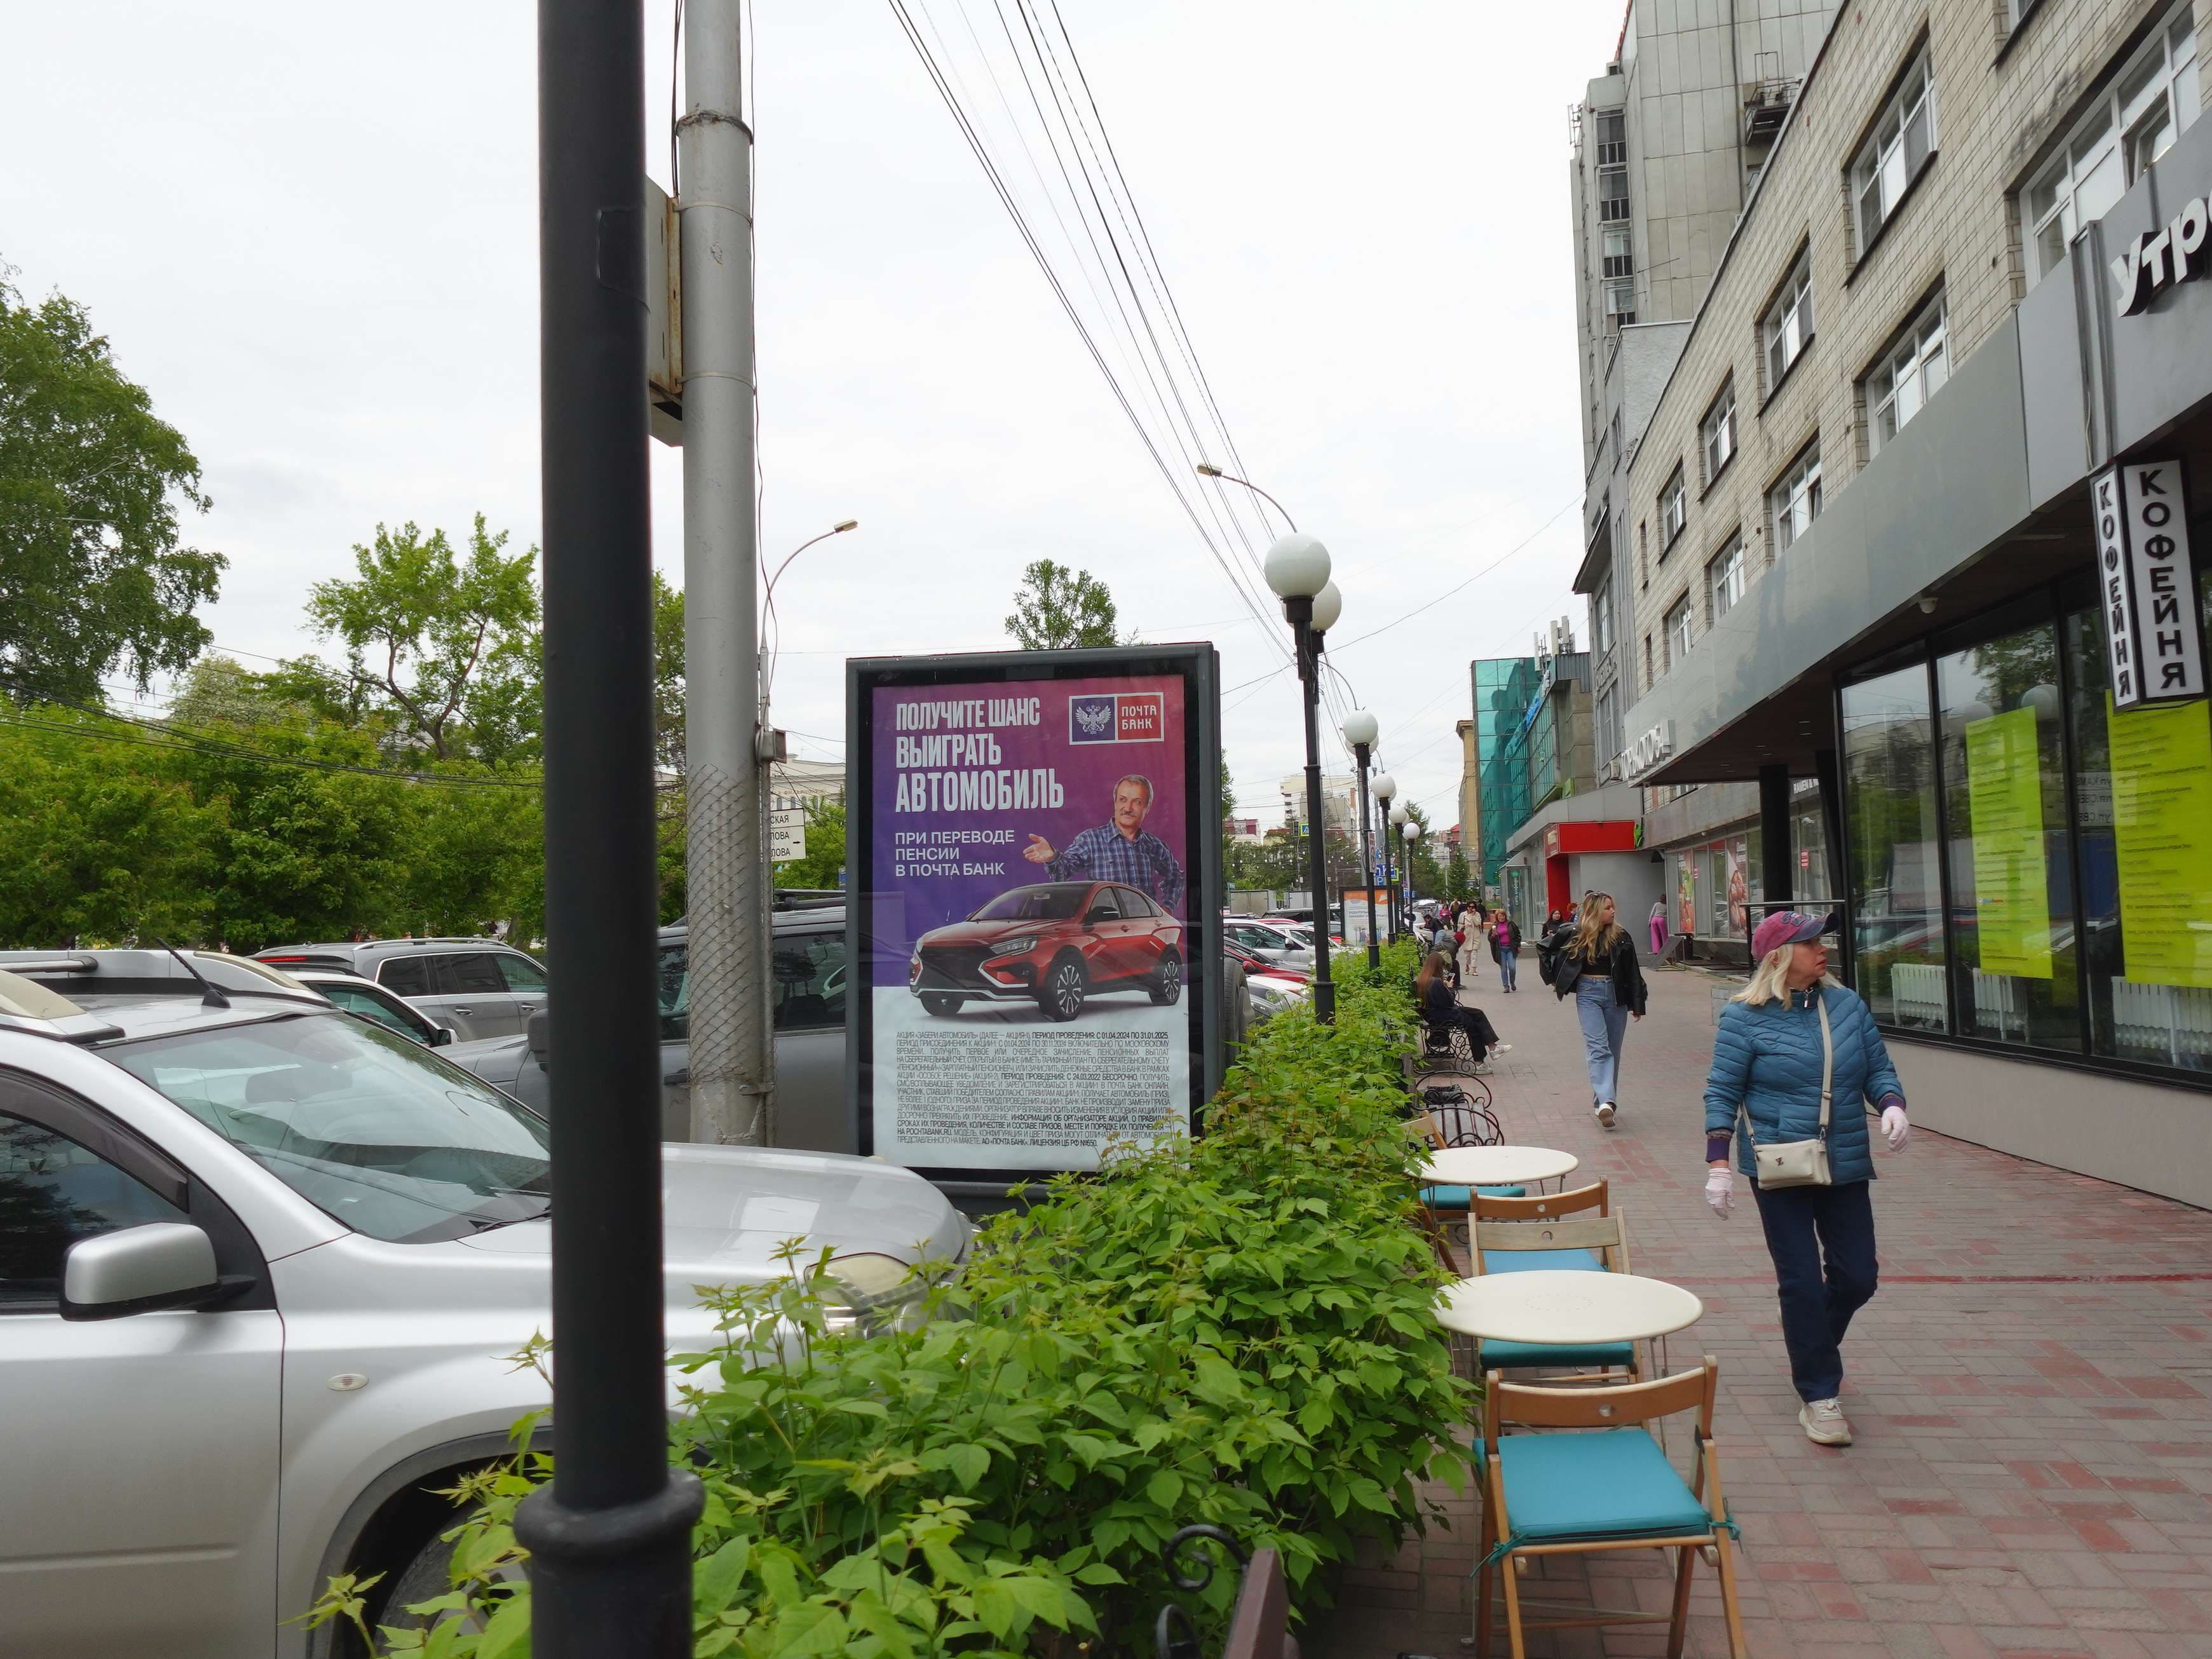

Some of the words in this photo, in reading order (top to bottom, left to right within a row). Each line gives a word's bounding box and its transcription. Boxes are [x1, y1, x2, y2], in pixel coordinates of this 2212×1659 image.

[2110, 188, 2212, 318] утр
[2139, 469, 2187, 689] КОФЕЙНЯ
[2098, 481, 2131, 698] КОФЕЙНЯ
[896, 700, 985, 731] ПОЛУЧИТЕ
[989, 697, 1040, 727] ШАНС
[1122, 706, 1157, 717] ПОЧТА
[1122, 718, 1153, 731] БАНК
[896, 733, 1001, 768] ВЫИГРАТЬ
[895, 768, 1064, 813] АВТОМОБИЛЬ
[770, 815, 789, 824] СКАЯ
[770, 832, 789, 841] ЛОВА
[895, 832, 926, 846] ПРИ
[931, 830, 1015, 845] ПЕРЕВОДЕ
[895, 848, 960, 861] ПЕНСИИ
[895, 864, 906, 877] В
[910, 863, 960, 877] ПОЧТА
[963, 862, 1005, 876] БАНК
